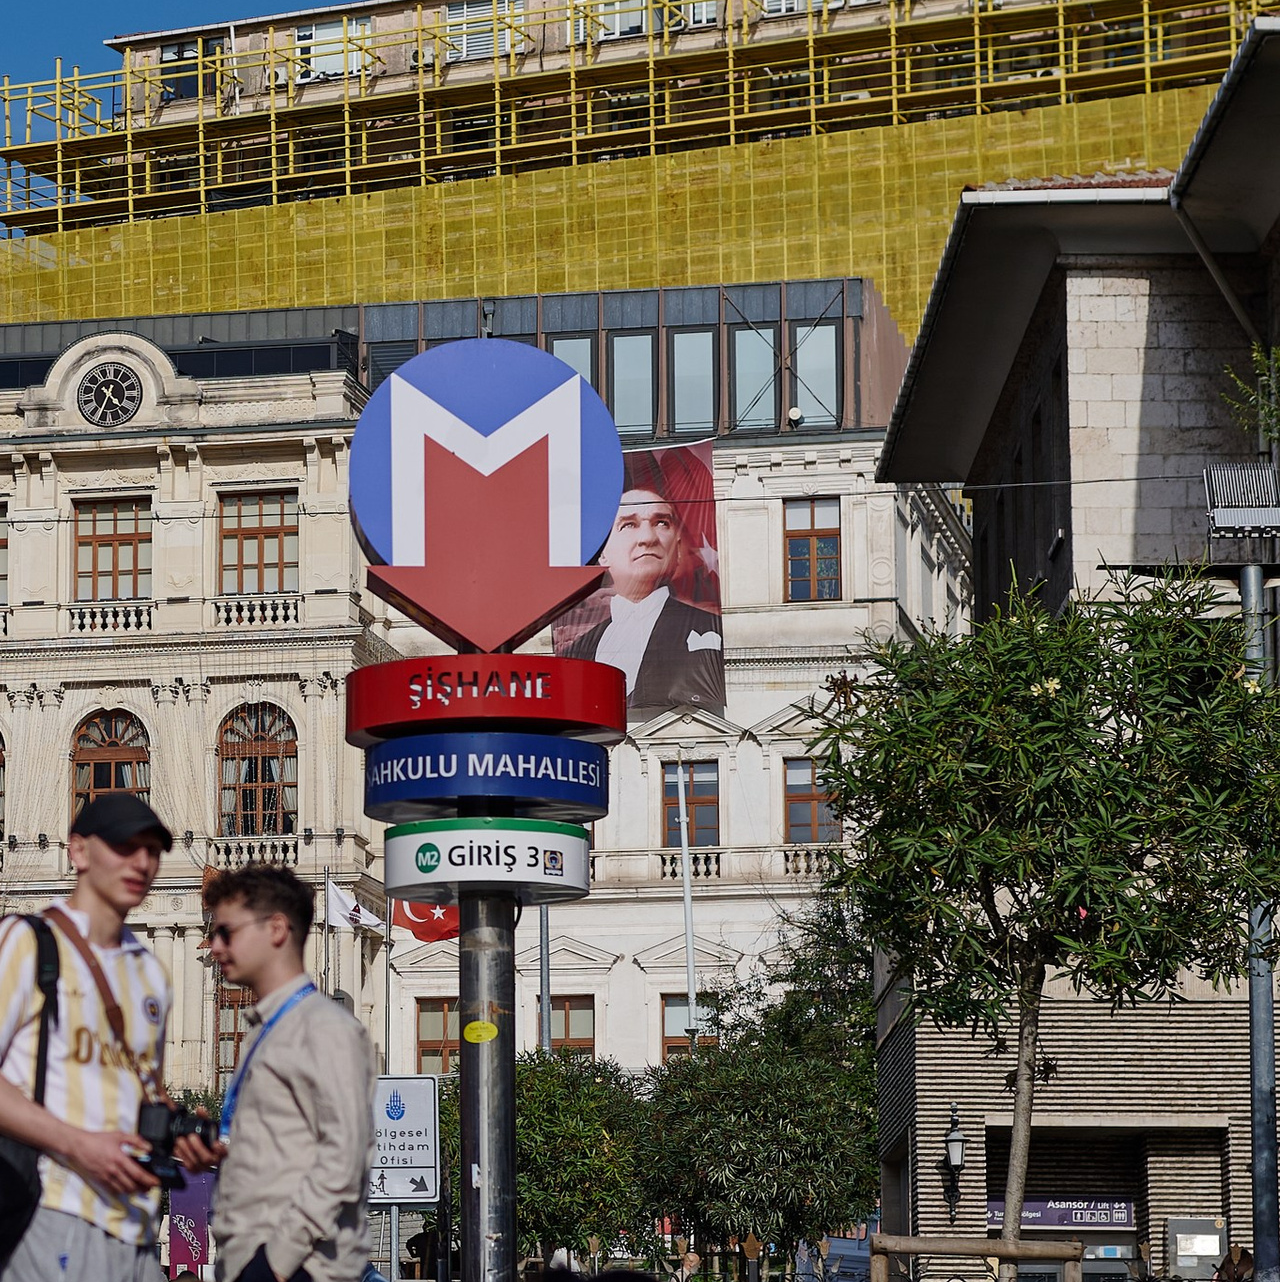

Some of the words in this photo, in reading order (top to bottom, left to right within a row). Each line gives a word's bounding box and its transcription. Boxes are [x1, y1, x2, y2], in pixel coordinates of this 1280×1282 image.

[408, 666, 552, 709] ŞİŞHANE
[467, 753, 600, 788] MAHALLESİ
[417, 850, 440, 867] M2
[447, 839, 517, 873] GİRİŞ
[526, 846, 540, 868] 3
[375, 1128, 427, 1139] ölgesel
[377, 1142, 429, 1151] tihdam
[380, 1155, 413, 1165] Ofisi
[1047, 1200, 1088, 1210] Asansör
[1021, 1210, 1041, 1219] ölgesi
